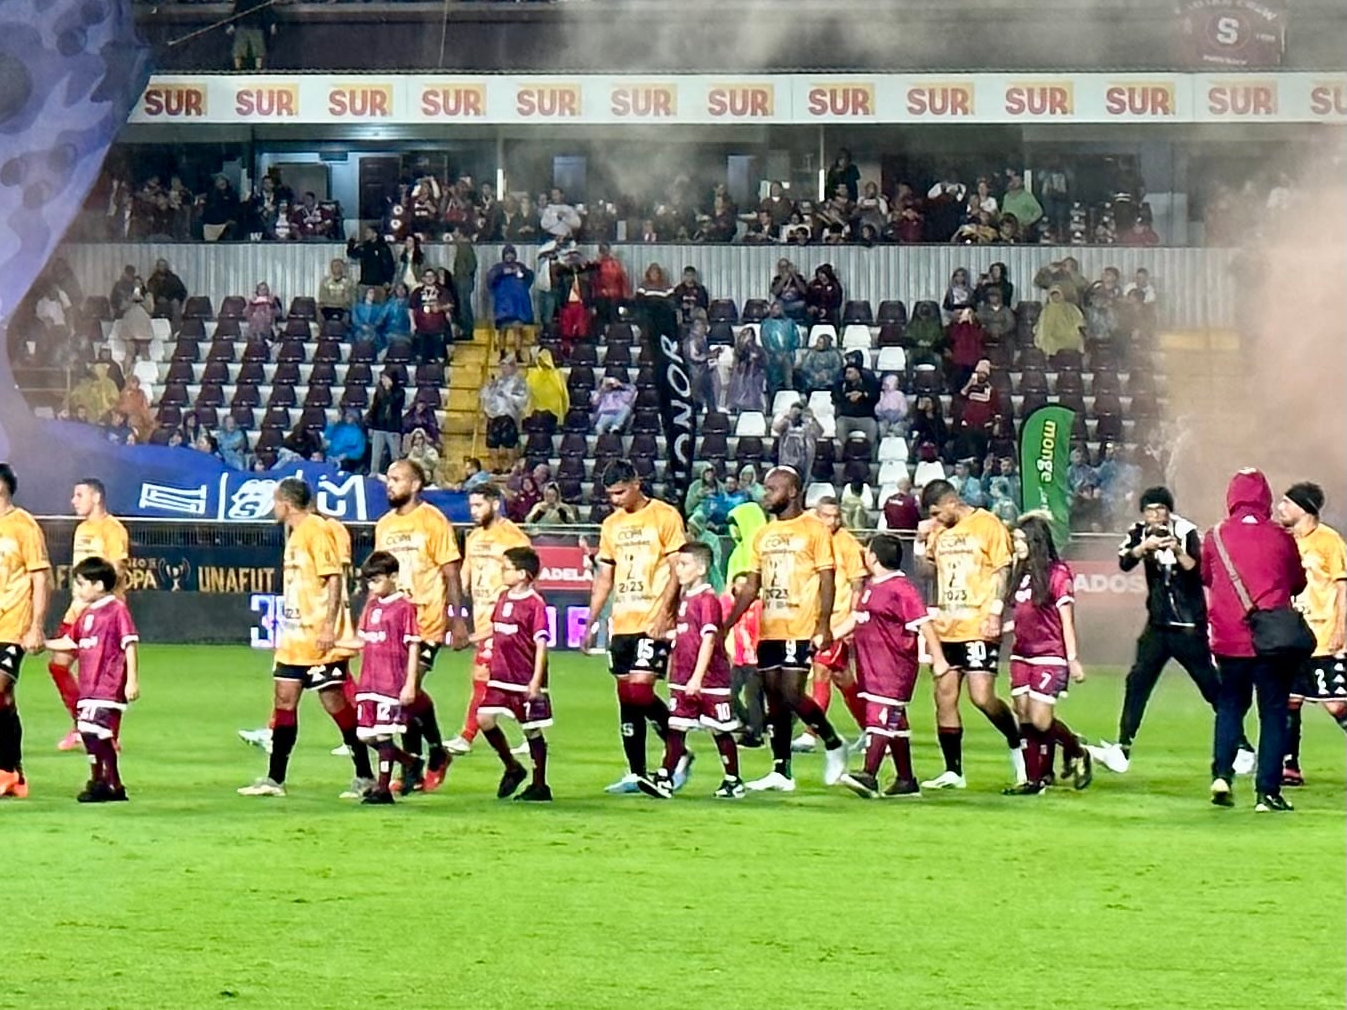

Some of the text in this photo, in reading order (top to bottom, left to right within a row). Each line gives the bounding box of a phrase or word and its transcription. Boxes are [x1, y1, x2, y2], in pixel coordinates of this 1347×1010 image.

[1216, 17, 1239, 44] S
[144, 89, 202, 116] SUR
[236, 89, 294, 116] SUR
[329, 88, 388, 116] SUR
[421, 88, 481, 116] SUR
[516, 88, 577, 116] SUR
[611, 88, 672, 116] SUR
[707, 87, 771, 116] SUR
[807, 87, 871, 116] SUR
[907, 87, 969, 116] SUR
[1005, 87, 1069, 116] SUR
[1106, 87, 1171, 116] SUR
[1208, 87, 1273, 116] SUR
[1037, 420, 1056, 482] monge
[198, 566, 276, 593] UNAFUT
[637, 638, 655, 659] 15
[966, 641, 987, 661] 30
[1038, 672, 1052, 690] 7
[715, 702, 731, 721] 10
